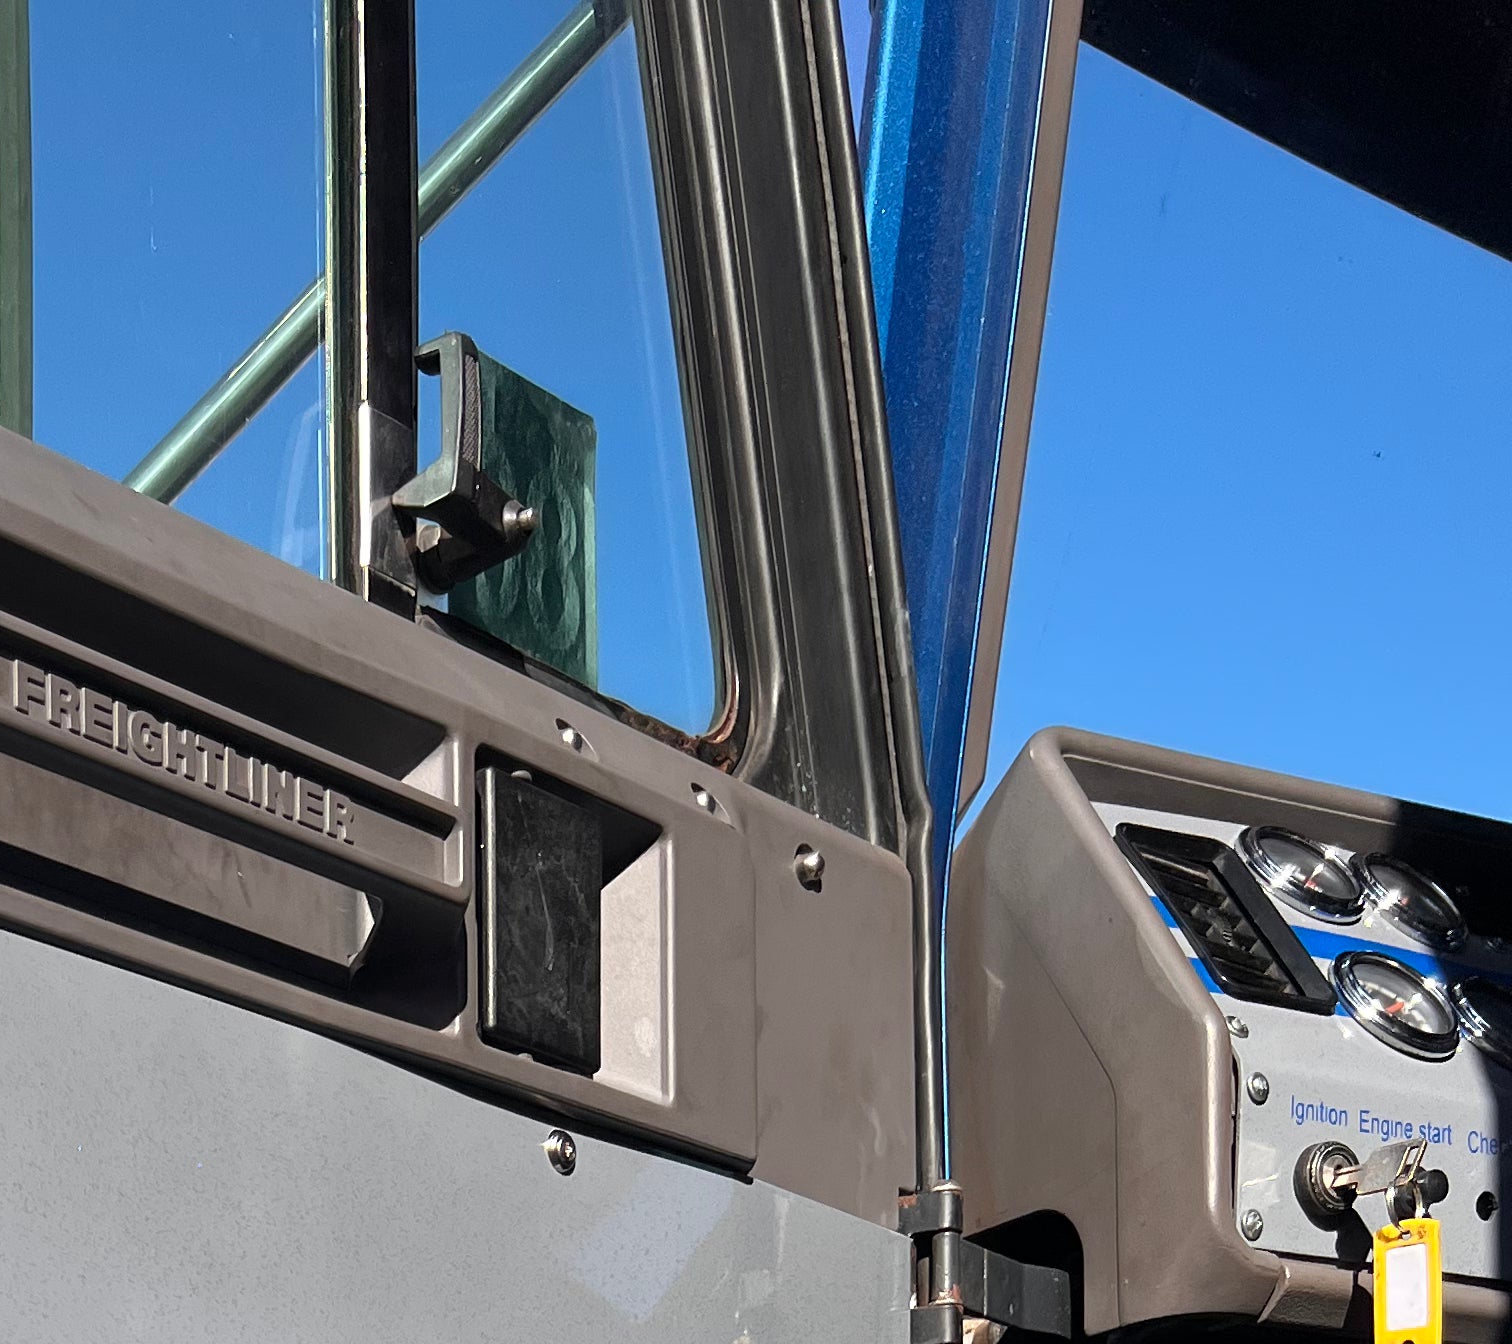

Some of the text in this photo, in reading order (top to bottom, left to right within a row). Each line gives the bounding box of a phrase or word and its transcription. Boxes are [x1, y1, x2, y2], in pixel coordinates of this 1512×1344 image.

[13, 659, 355, 845] FREIGHTLINER
[1290, 1094, 1349, 1126] Ignition
[1358, 1109, 1453, 1146] Engine start
